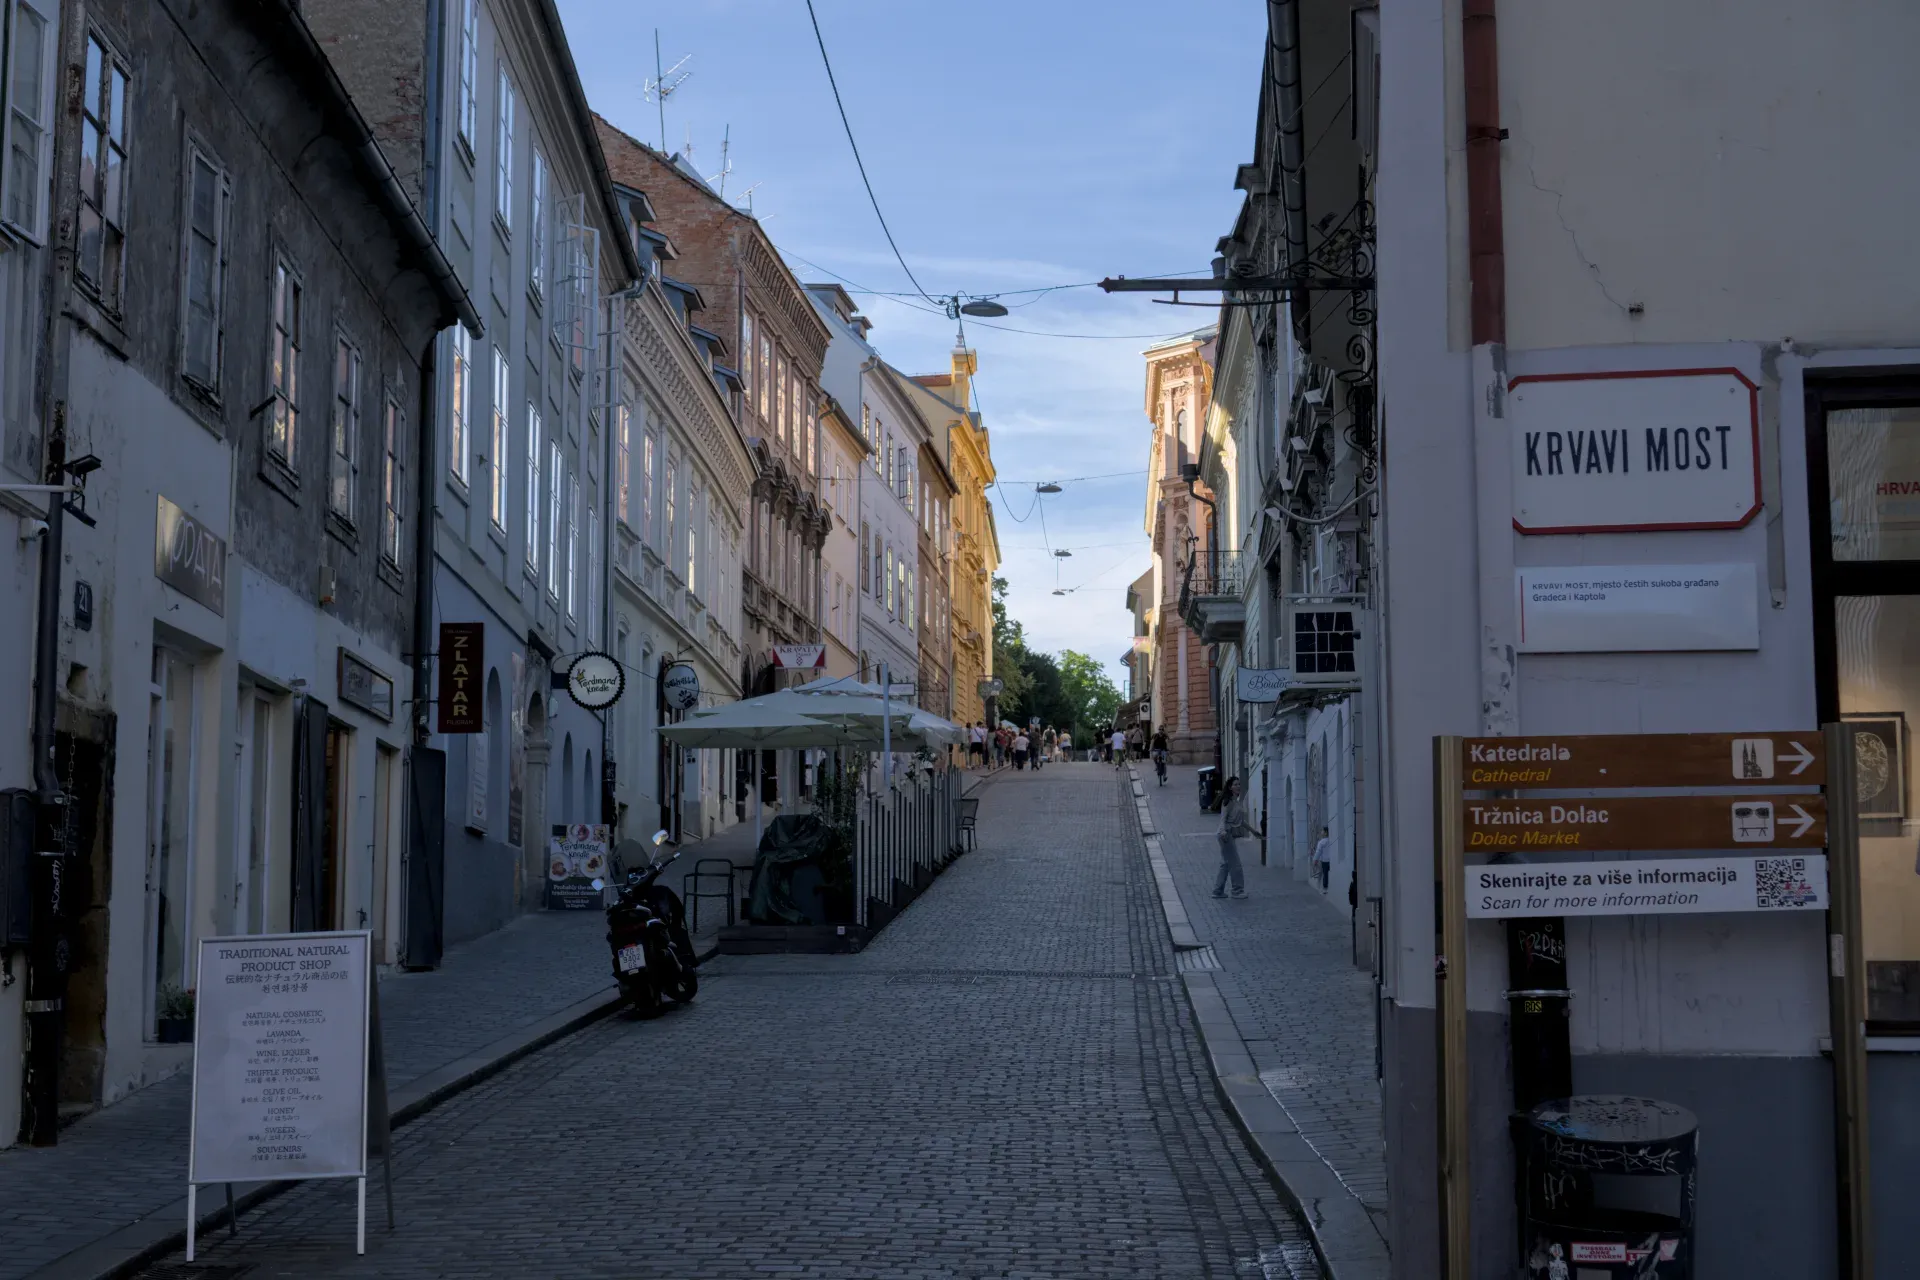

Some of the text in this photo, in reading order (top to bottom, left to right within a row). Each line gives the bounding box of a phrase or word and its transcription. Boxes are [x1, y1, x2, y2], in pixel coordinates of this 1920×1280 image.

[1525, 426, 1731, 476] KRVAVI MOST
[1532, 578, 1719, 590] KRVAVI MOST, mjesto čestih sukoba građana
[79, 585, 88, 613] 21
[1532, 592, 1567, 602] Gradeca
[1574, 592, 1606, 602] Kaptola
[452, 636, 469, 716] ZLATAR
[578, 674, 617, 688] Ferdinand
[1470, 742, 1571, 761] Katedrala
[1471, 767, 1552, 783] Cathedral
[1470, 804, 1609, 825] Tržnica Dolac
[1470, 830, 1580, 846] Dolac Market
[1480, 866, 1737, 889] Skenirajte za više informacija
[1481, 892, 1699, 910] Scan for more information
[218, 945, 350, 960] TRADITIONAL NATURAL
[241, 959, 331, 972] PRODUCT SHOP
[246, 1010, 323, 1020] NATURAL COSMETIC
[266, 1029, 301, 1037] LAVANDA
[281, 1048, 311, 1056] LIQUER
[246, 1067, 318, 1077] TRUFFLE PRODUCT
[262, 1087, 301, 1096] OLIVE OIL
[267, 1107, 295, 1115] HONEY
[264, 1126, 296, 1134] SWEETS
[256, 1145, 302, 1154] SOUVENIRS
